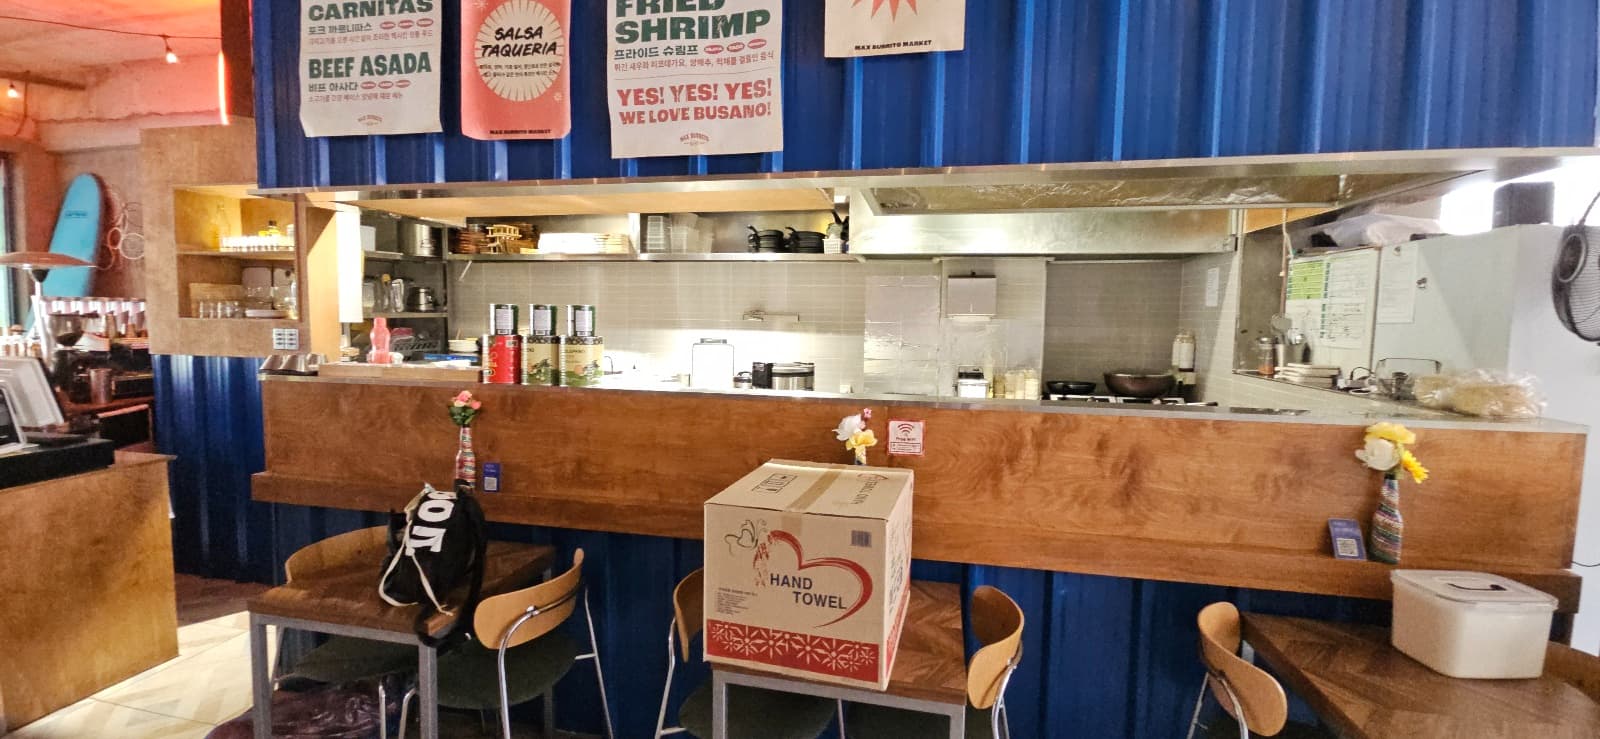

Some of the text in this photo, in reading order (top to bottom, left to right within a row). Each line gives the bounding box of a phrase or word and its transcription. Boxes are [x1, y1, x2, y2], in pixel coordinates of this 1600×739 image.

[308, 0, 433, 21] CARNITAS
[308, 26, 326, 35] 포크
[494, 26, 543, 40] SALSA
[615, 9, 771, 44] SHRIMP
[481, 42, 557, 57] TAQUERIA
[614, 46, 659, 60] 프라이드
[663, 44, 698, 56] 슈림프
[308, 52, 432, 79] BEEF ASADA
[308, 83, 327, 92] 비프
[329, 82, 359, 92] 아사다
[617, 78, 772, 106] YES! YES! YES!
[619, 102, 771, 125] WE LOVE BUSANO!
[769, 573, 813, 590] HAND
[792, 591, 847, 610] TOWEL
